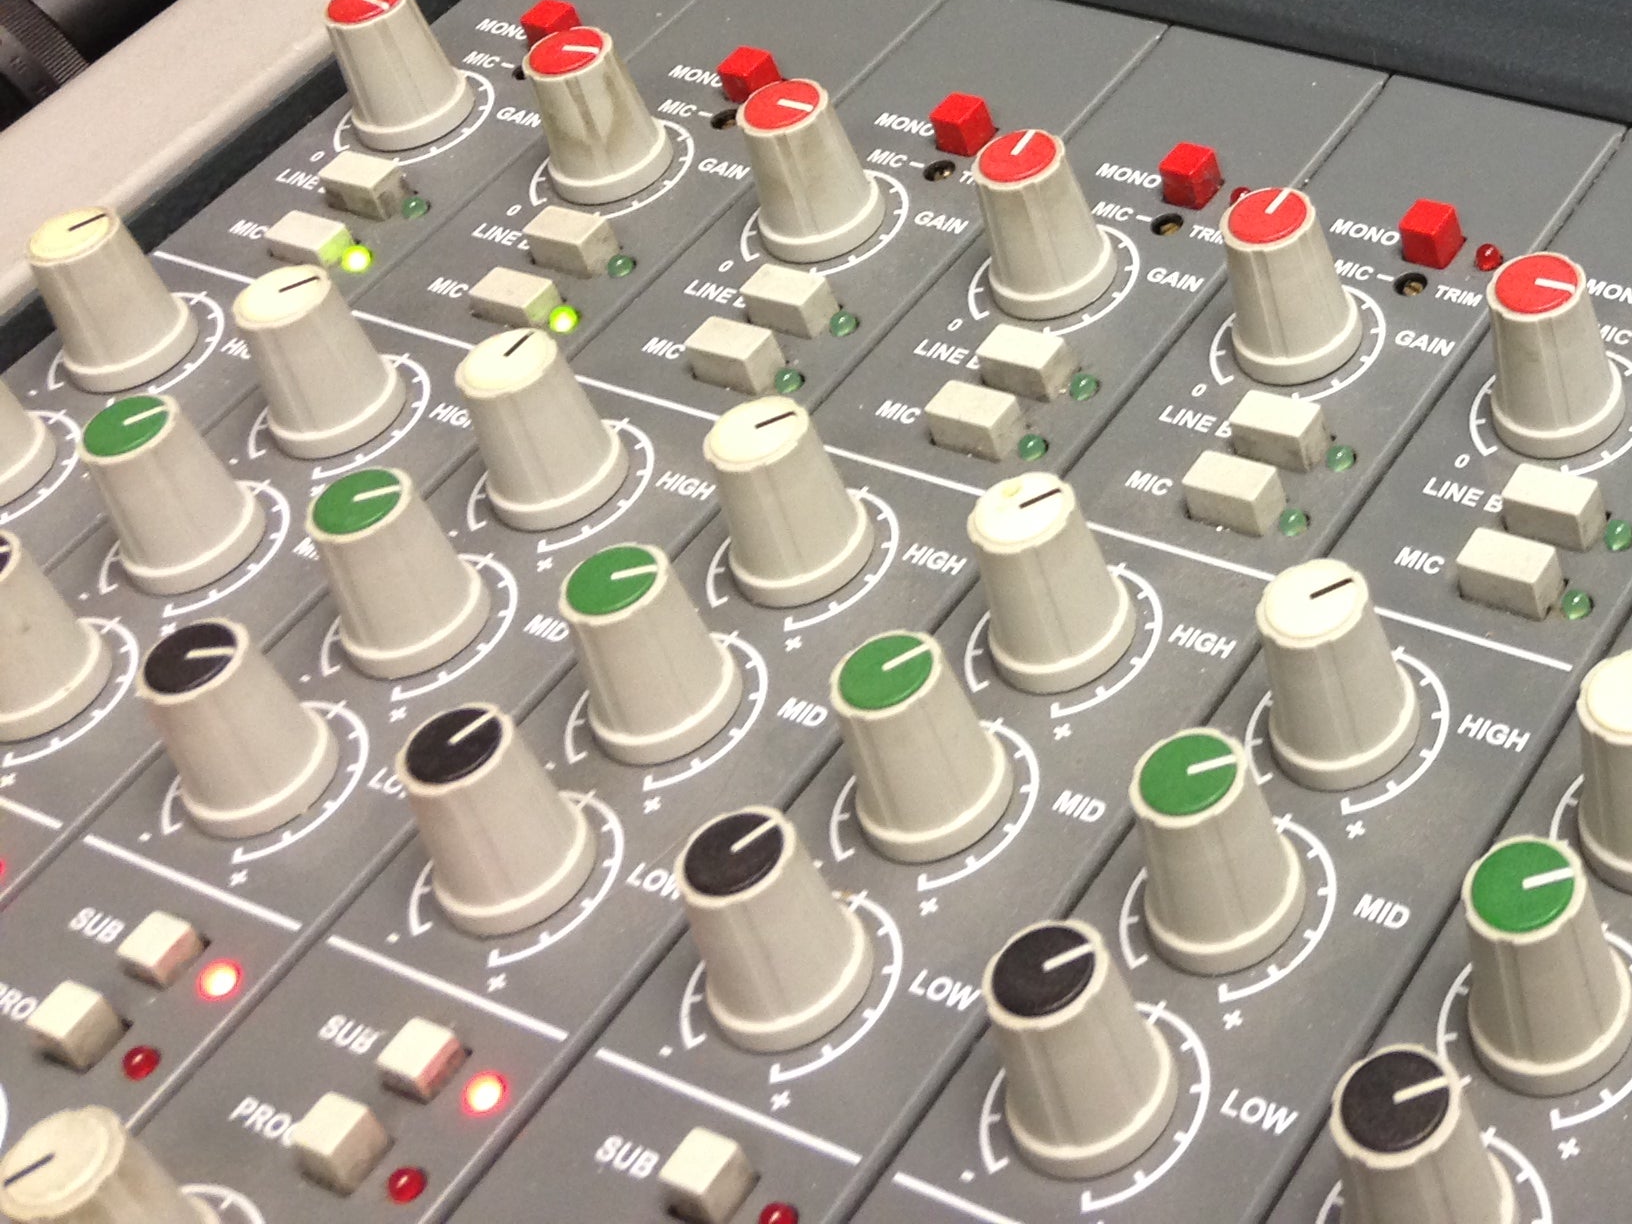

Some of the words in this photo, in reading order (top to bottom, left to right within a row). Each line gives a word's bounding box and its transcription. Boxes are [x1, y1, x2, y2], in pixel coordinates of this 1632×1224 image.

[462, 51, 499, 69] MIC
[496, 106, 542, 129] GAIN
[658, 98, 697, 117] MIC
[874, 111, 935, 138] MONO
[698, 157, 751, 181] GAIN
[866, 148, 907, 168] MIC
[275, 168, 320, 191] LINE
[1095, 162, 1162, 189] MONO
[914, 210, 969, 236] GAIN
[1091, 201, 1134, 223] MIC
[229, 219, 269, 240] MIC
[471, 222, 522, 246] LINE
[1329, 218, 1400, 246] MONO
[1147, 267, 1205, 294] GAIN
[1333, 258, 1374, 281] MIC
[427, 276, 469, 299] MIC
[683, 279, 736, 304] LINE
[1434, 284, 1483, 308] TRIM
[641, 336, 686, 360] MIC
[913, 338, 970, 366] LINE
[1394, 329, 1456, 358] GAIN
[875, 400, 921, 425] MIC
[1158, 404, 1217, 432] LINE
[655, 470, 717, 502] HIGH
[1125, 469, 1173, 496] MIC
[1422, 476, 1486, 507] LINE
[1482, 493, 1503, 514] B
[902, 542, 968, 577] HIGH
[1394, 545, 1446, 575] MIC
[522, 612, 570, 643] MID
[1167, 623, 1238, 660] HIGH
[776, 695, 829, 728] MID
[1456, 712, 1532, 753] HIGH
[367, 766, 406, 799] LO
[1052, 789, 1107, 824] MID
[626, 862, 680, 901] LOW
[1352, 893, 1411, 930] MID
[68, 907, 126, 945] SUB
[908, 968, 982, 1011] LOW
[1219, 1088, 1299, 1136] LOW
[594, 1132, 661, 1180] SUB
